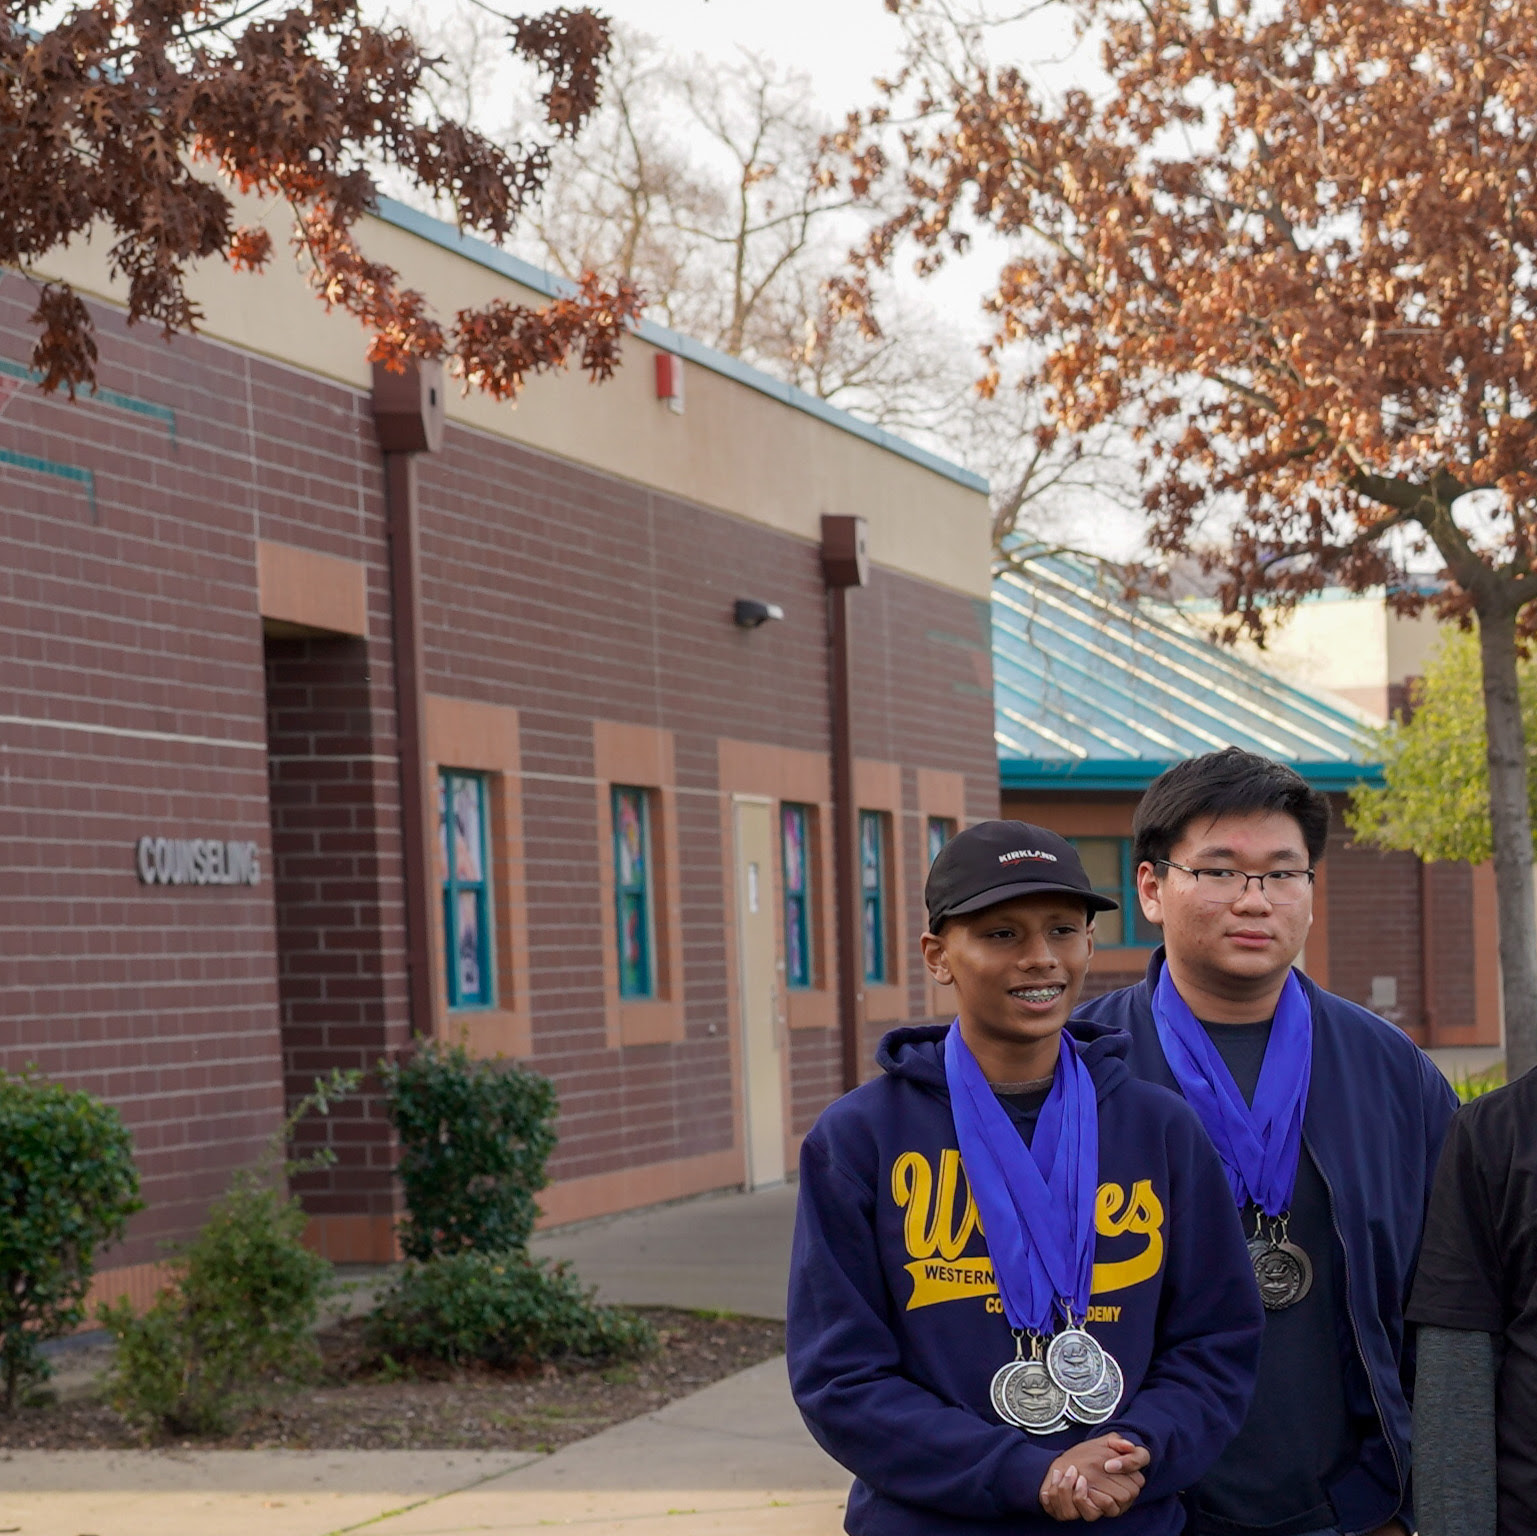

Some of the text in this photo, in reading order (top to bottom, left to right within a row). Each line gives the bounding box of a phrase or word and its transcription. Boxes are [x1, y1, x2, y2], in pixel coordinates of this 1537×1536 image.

[138, 836, 261, 886] COUNSELING
[998, 849, 1058, 863] KIRKLAND
[891, 1148, 1165, 1261] Wes
[925, 1264, 996, 1285] WESTERN
